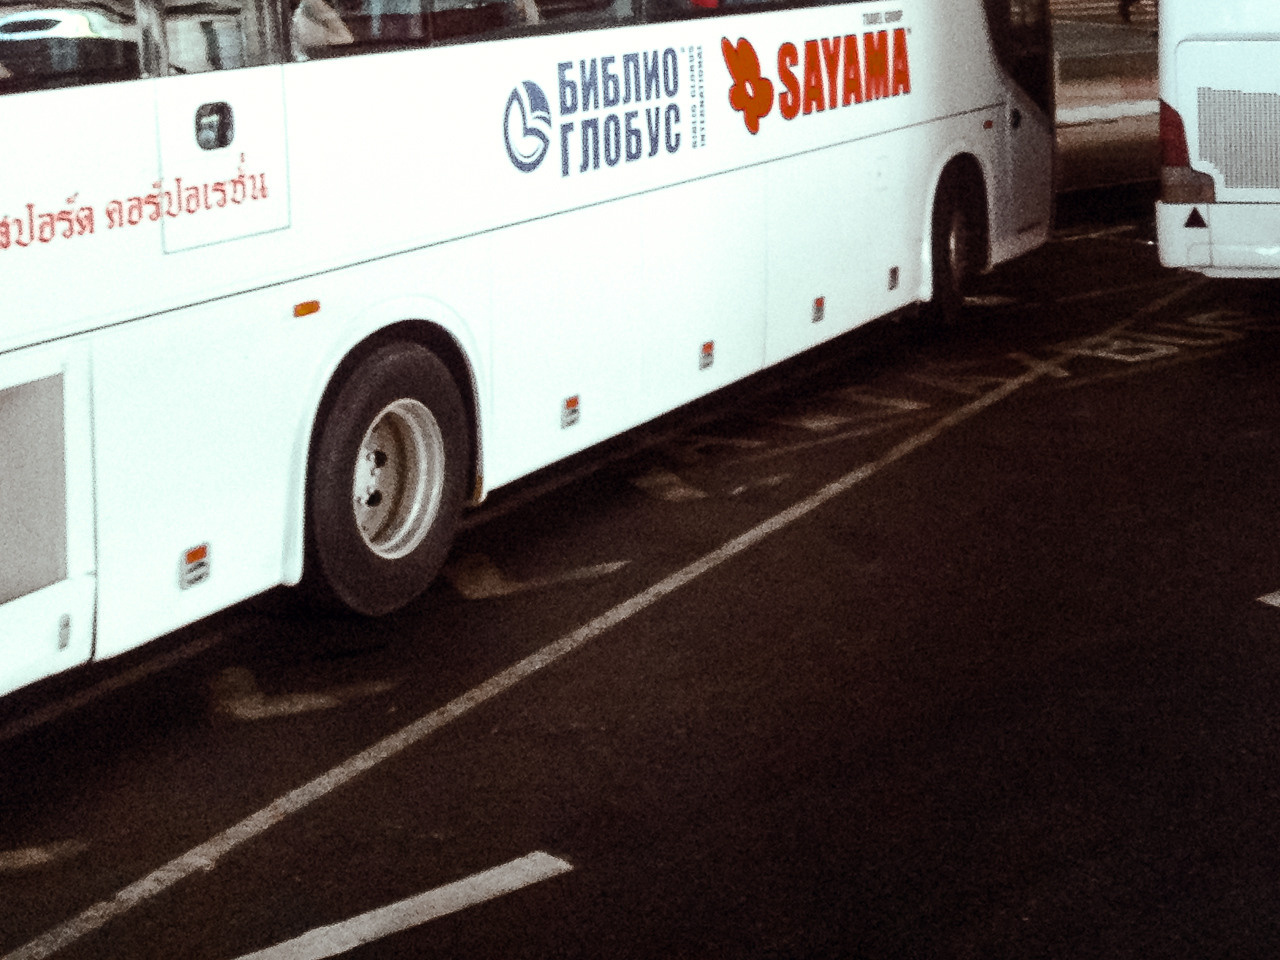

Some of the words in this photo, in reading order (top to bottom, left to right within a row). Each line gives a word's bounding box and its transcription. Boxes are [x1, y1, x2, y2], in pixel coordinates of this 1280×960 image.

[557, 47, 679, 116] БИБЛИО
[777, 28, 911, 120] SAYAMA
[559, 103, 680, 178] ГЛОБУС
